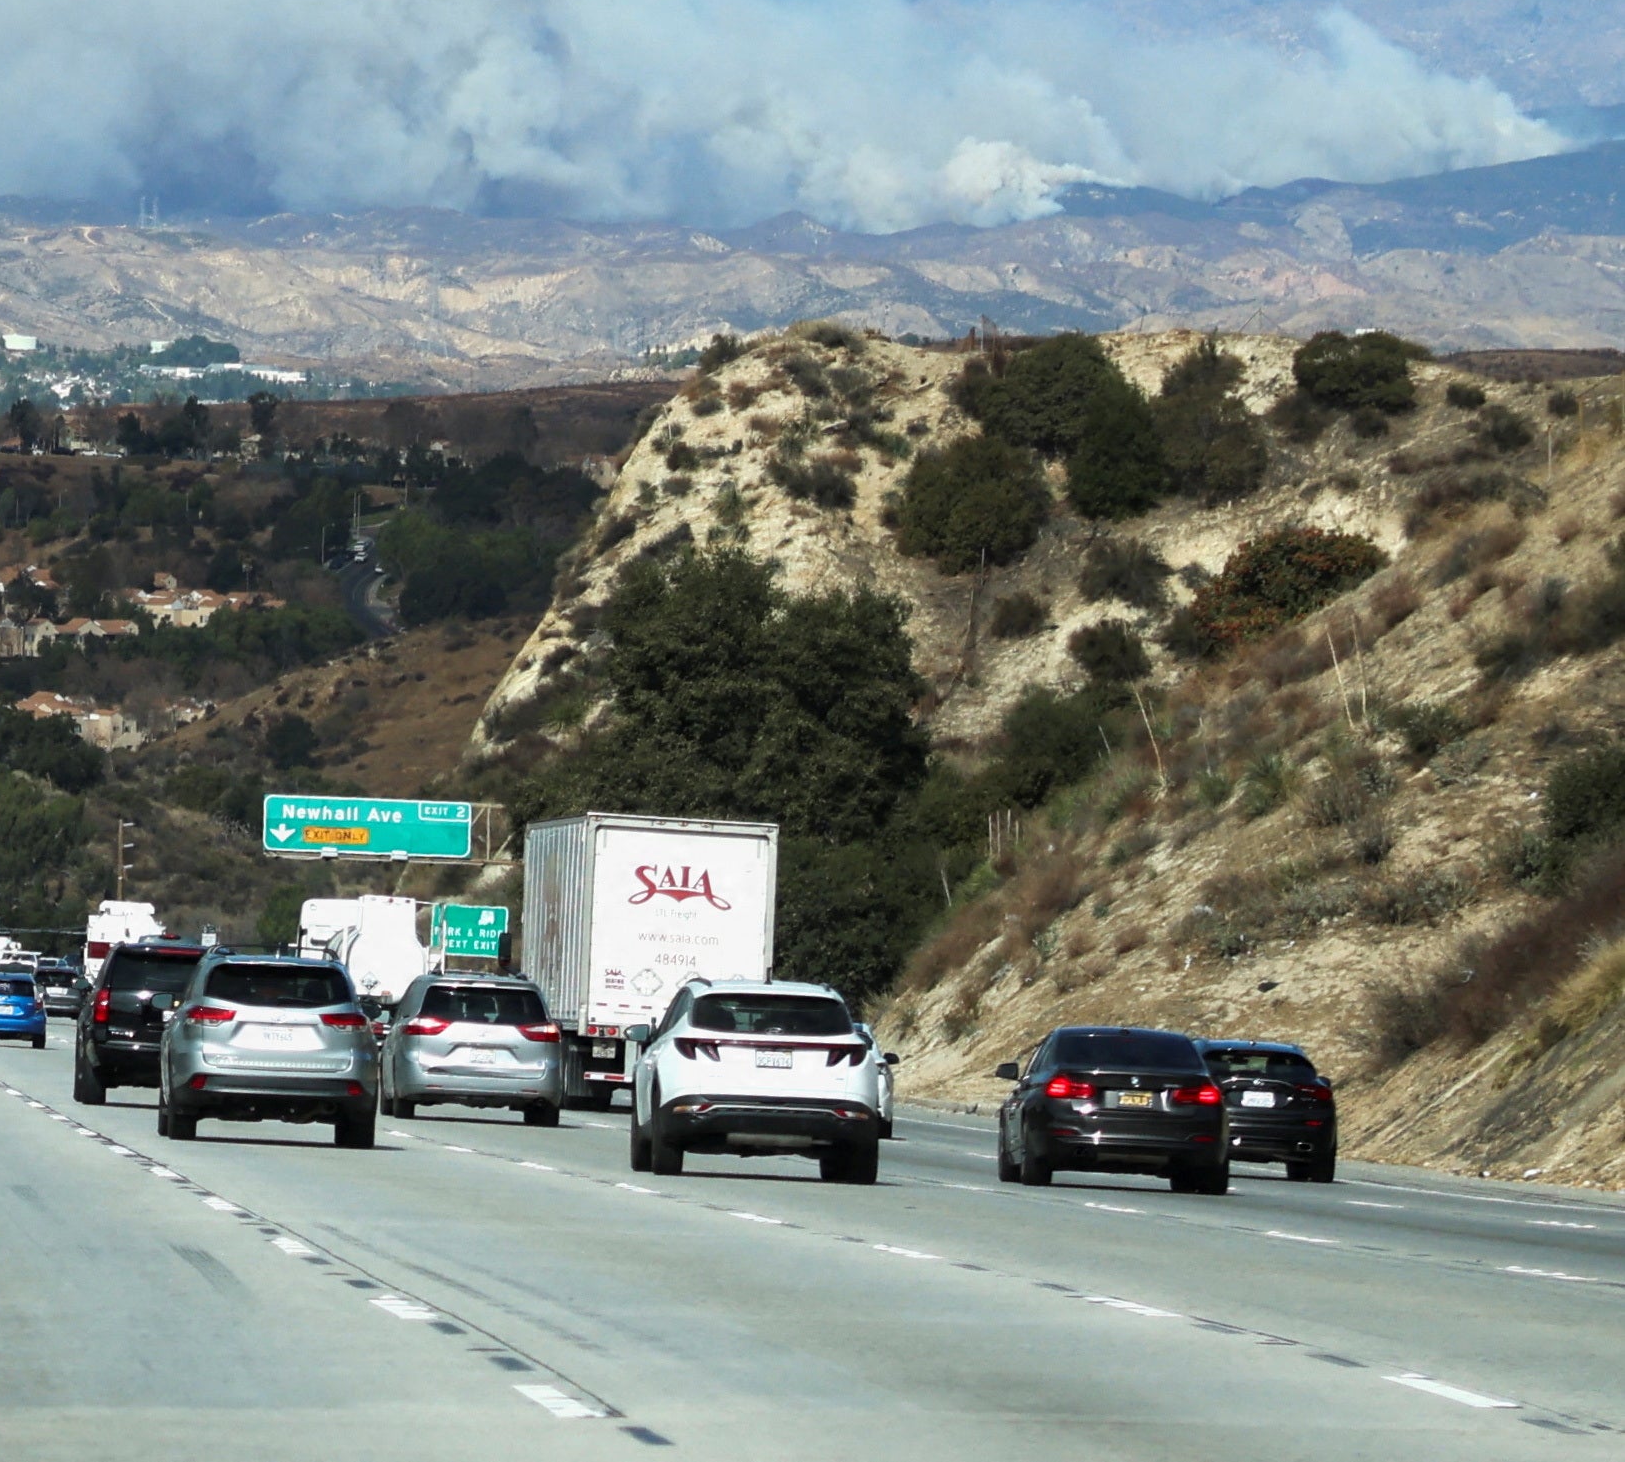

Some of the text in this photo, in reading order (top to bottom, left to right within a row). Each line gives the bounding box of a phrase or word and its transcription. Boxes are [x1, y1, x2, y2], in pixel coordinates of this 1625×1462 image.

[282, 804, 403, 823] Newhall Ave
[424, 806, 466, 818] EXIT 2
[305, 830, 365, 842] EXIT ONLY
[628, 864, 732, 911] SAIA
[671, 909, 697, 920] Freight
[434, 925, 461, 937] PRK
[442, 938, 497, 951] EXT EXIT
[638, 932, 719, 946] www.saia.com
[654, 953, 697, 968] 484914
